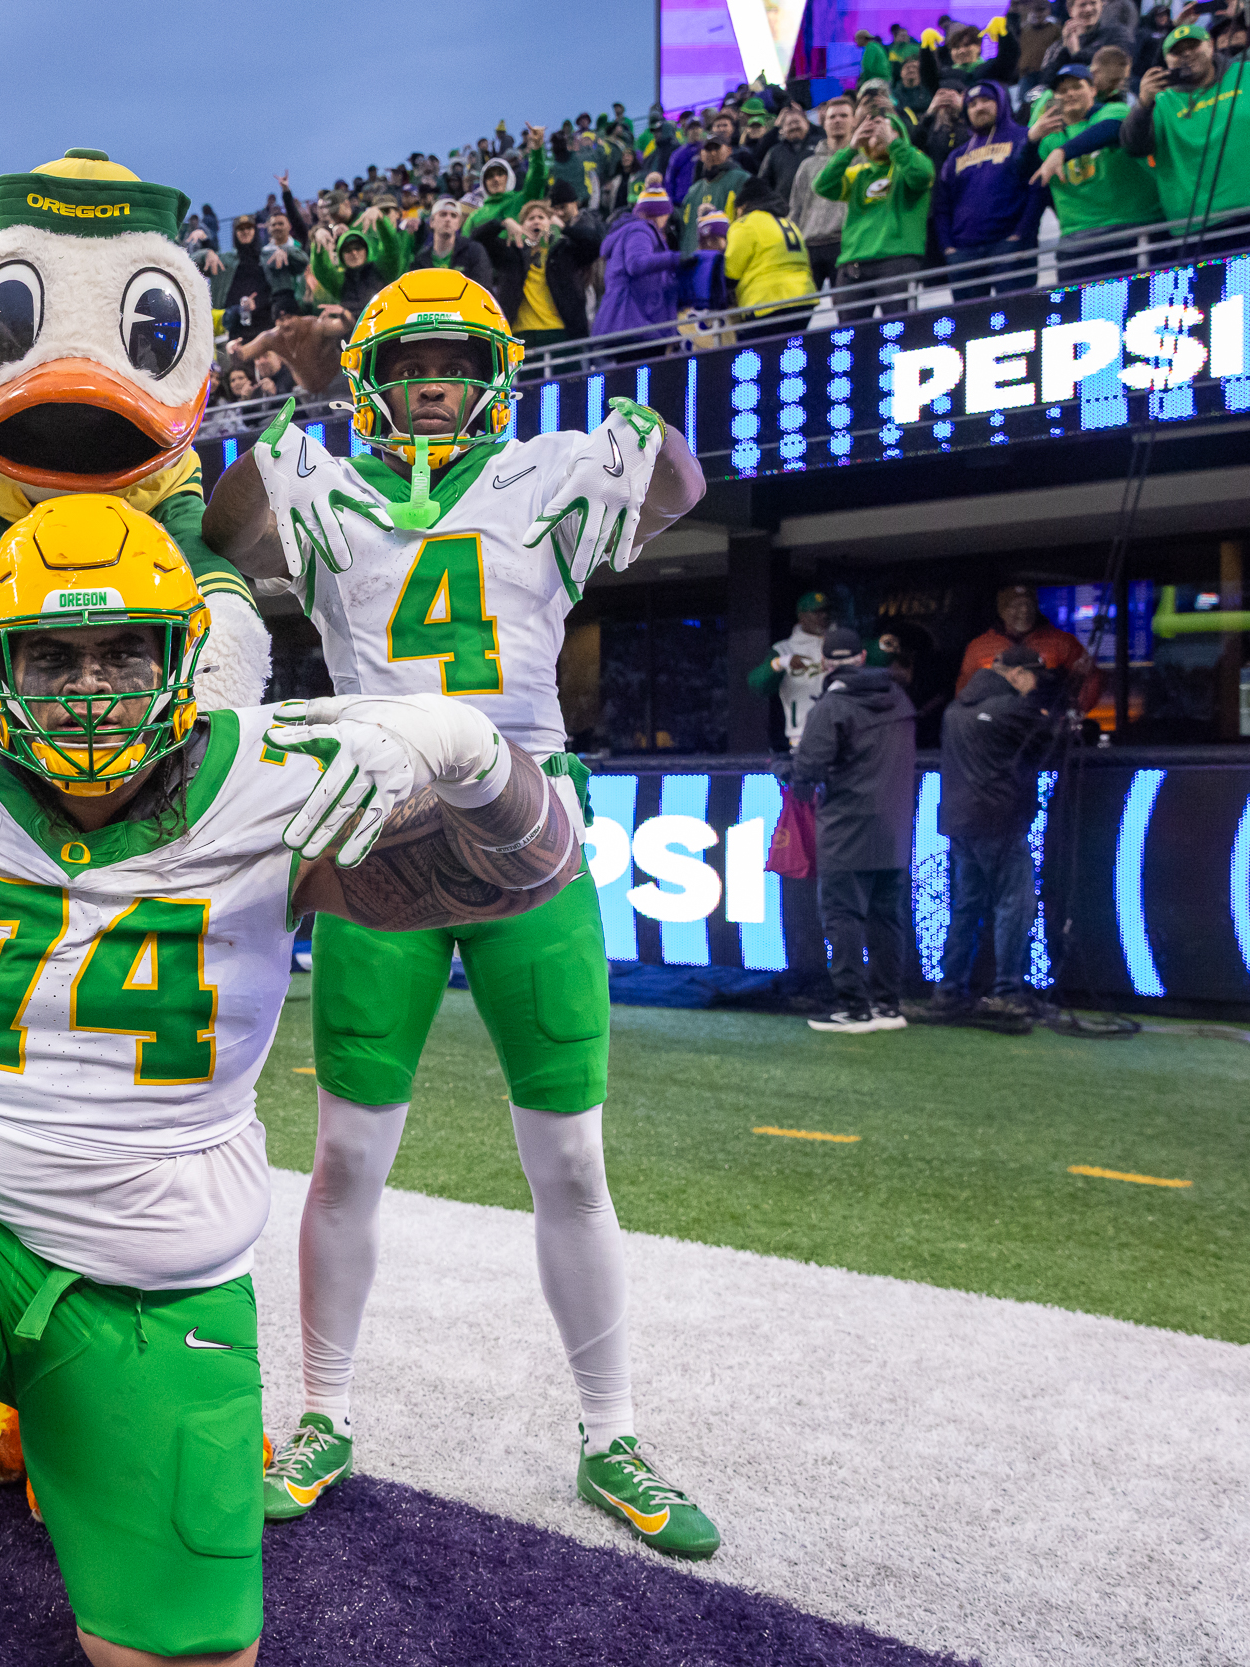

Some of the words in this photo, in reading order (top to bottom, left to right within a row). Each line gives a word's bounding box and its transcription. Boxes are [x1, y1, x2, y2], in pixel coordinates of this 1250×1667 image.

[27, 193, 131, 218] OREGON
[892, 294, 1244, 425] PEPSI
[59, 591, 107, 607] OREGON
[387, 533, 503, 696] 4
